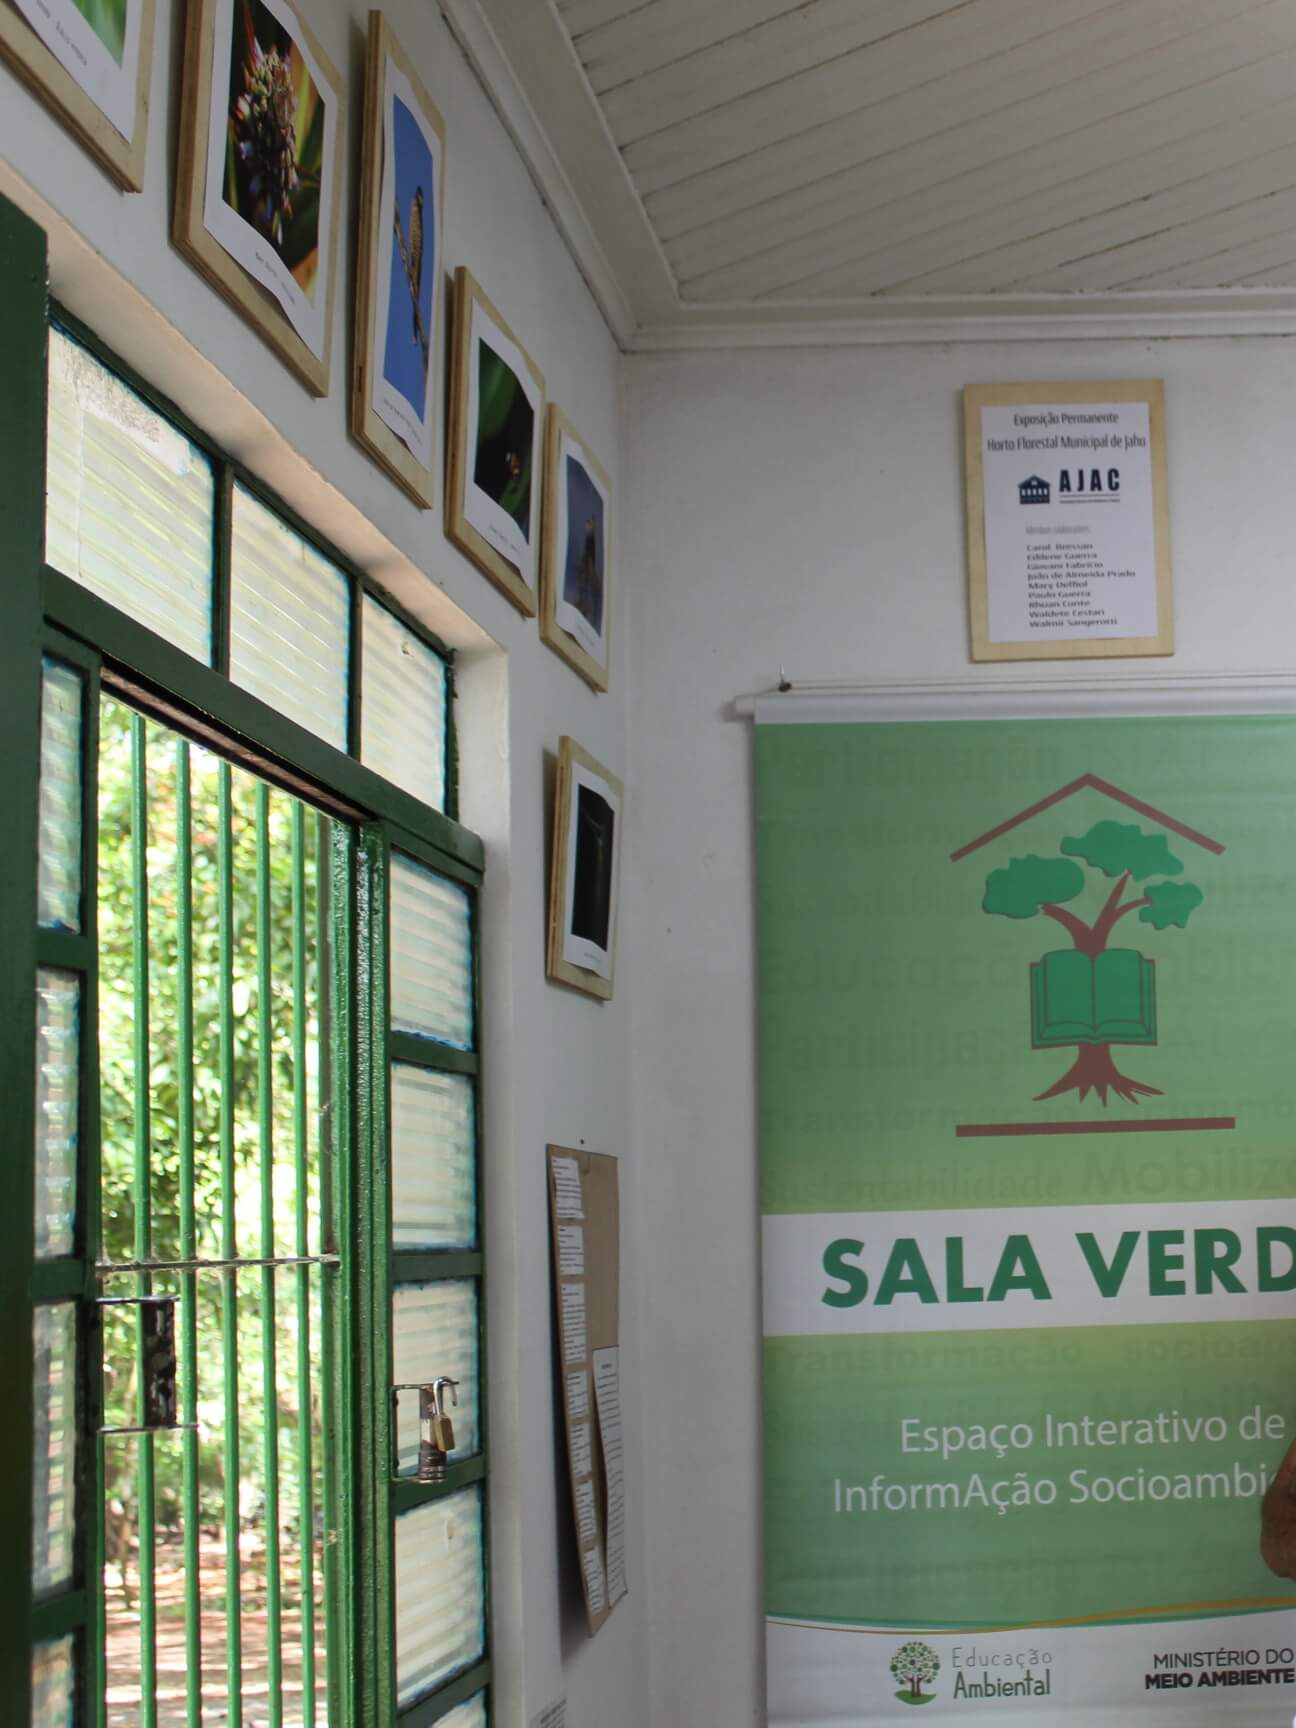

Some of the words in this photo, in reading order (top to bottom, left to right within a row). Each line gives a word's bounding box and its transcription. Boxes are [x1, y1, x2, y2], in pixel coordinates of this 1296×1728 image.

[1013, 413, 1060, 428] Exposição
[1061, 412, 1119, 425] Permanente
[987, 438, 1015, 451] Horto
[1017, 436, 1058, 450] Florestal
[1060, 434, 1108, 452] Municipal
[1110, 434, 1122, 447] de
[1124, 433, 1146, 451] Jahu
[1059, 467, 1120, 493] AJAC
[820, 1233, 1053, 1309] SALA
[900, 1417, 1034, 1460] Espaço
[1045, 1409, 1228, 1449] Interativo
[1237, 1405, 1287, 1442] de
[833, 1470, 1058, 1515] InformAção
[1068, 1462, 1277, 1504] Socioambi
[952, 1647, 1053, 1670] Educação
[1153, 1647, 1261, 1669] MINISTÉRIO
[1265, 1647, 1295, 1665] DO
[953, 1669, 1051, 1700] Ambiental
[1144, 1672, 1193, 1690] MEIO
[1197, 1667, 1295, 1688] AMBIENTE
